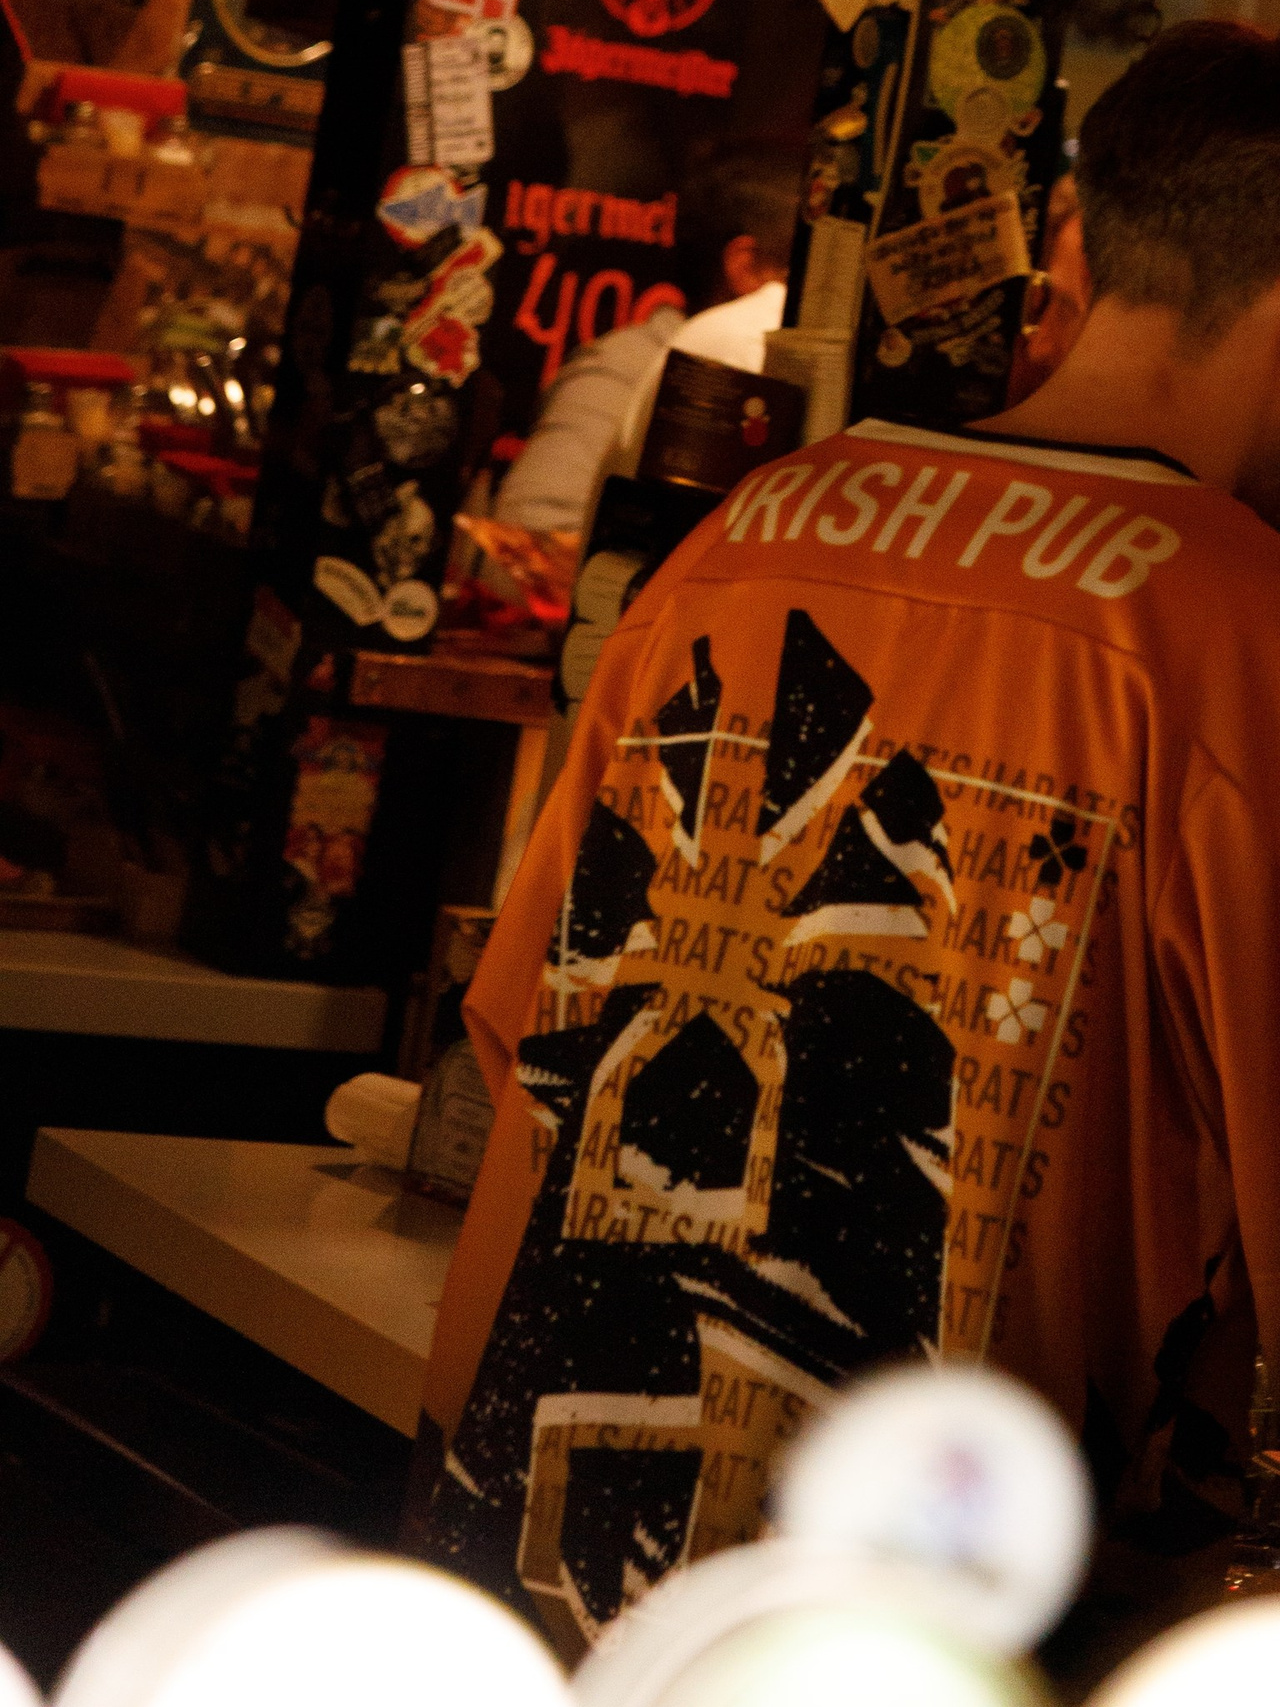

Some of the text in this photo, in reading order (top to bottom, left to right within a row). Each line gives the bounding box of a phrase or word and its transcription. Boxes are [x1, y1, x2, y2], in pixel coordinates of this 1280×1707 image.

[726, 460, 1182, 599] IRISH PUB
[650, 847, 795, 915] ARAT'S
